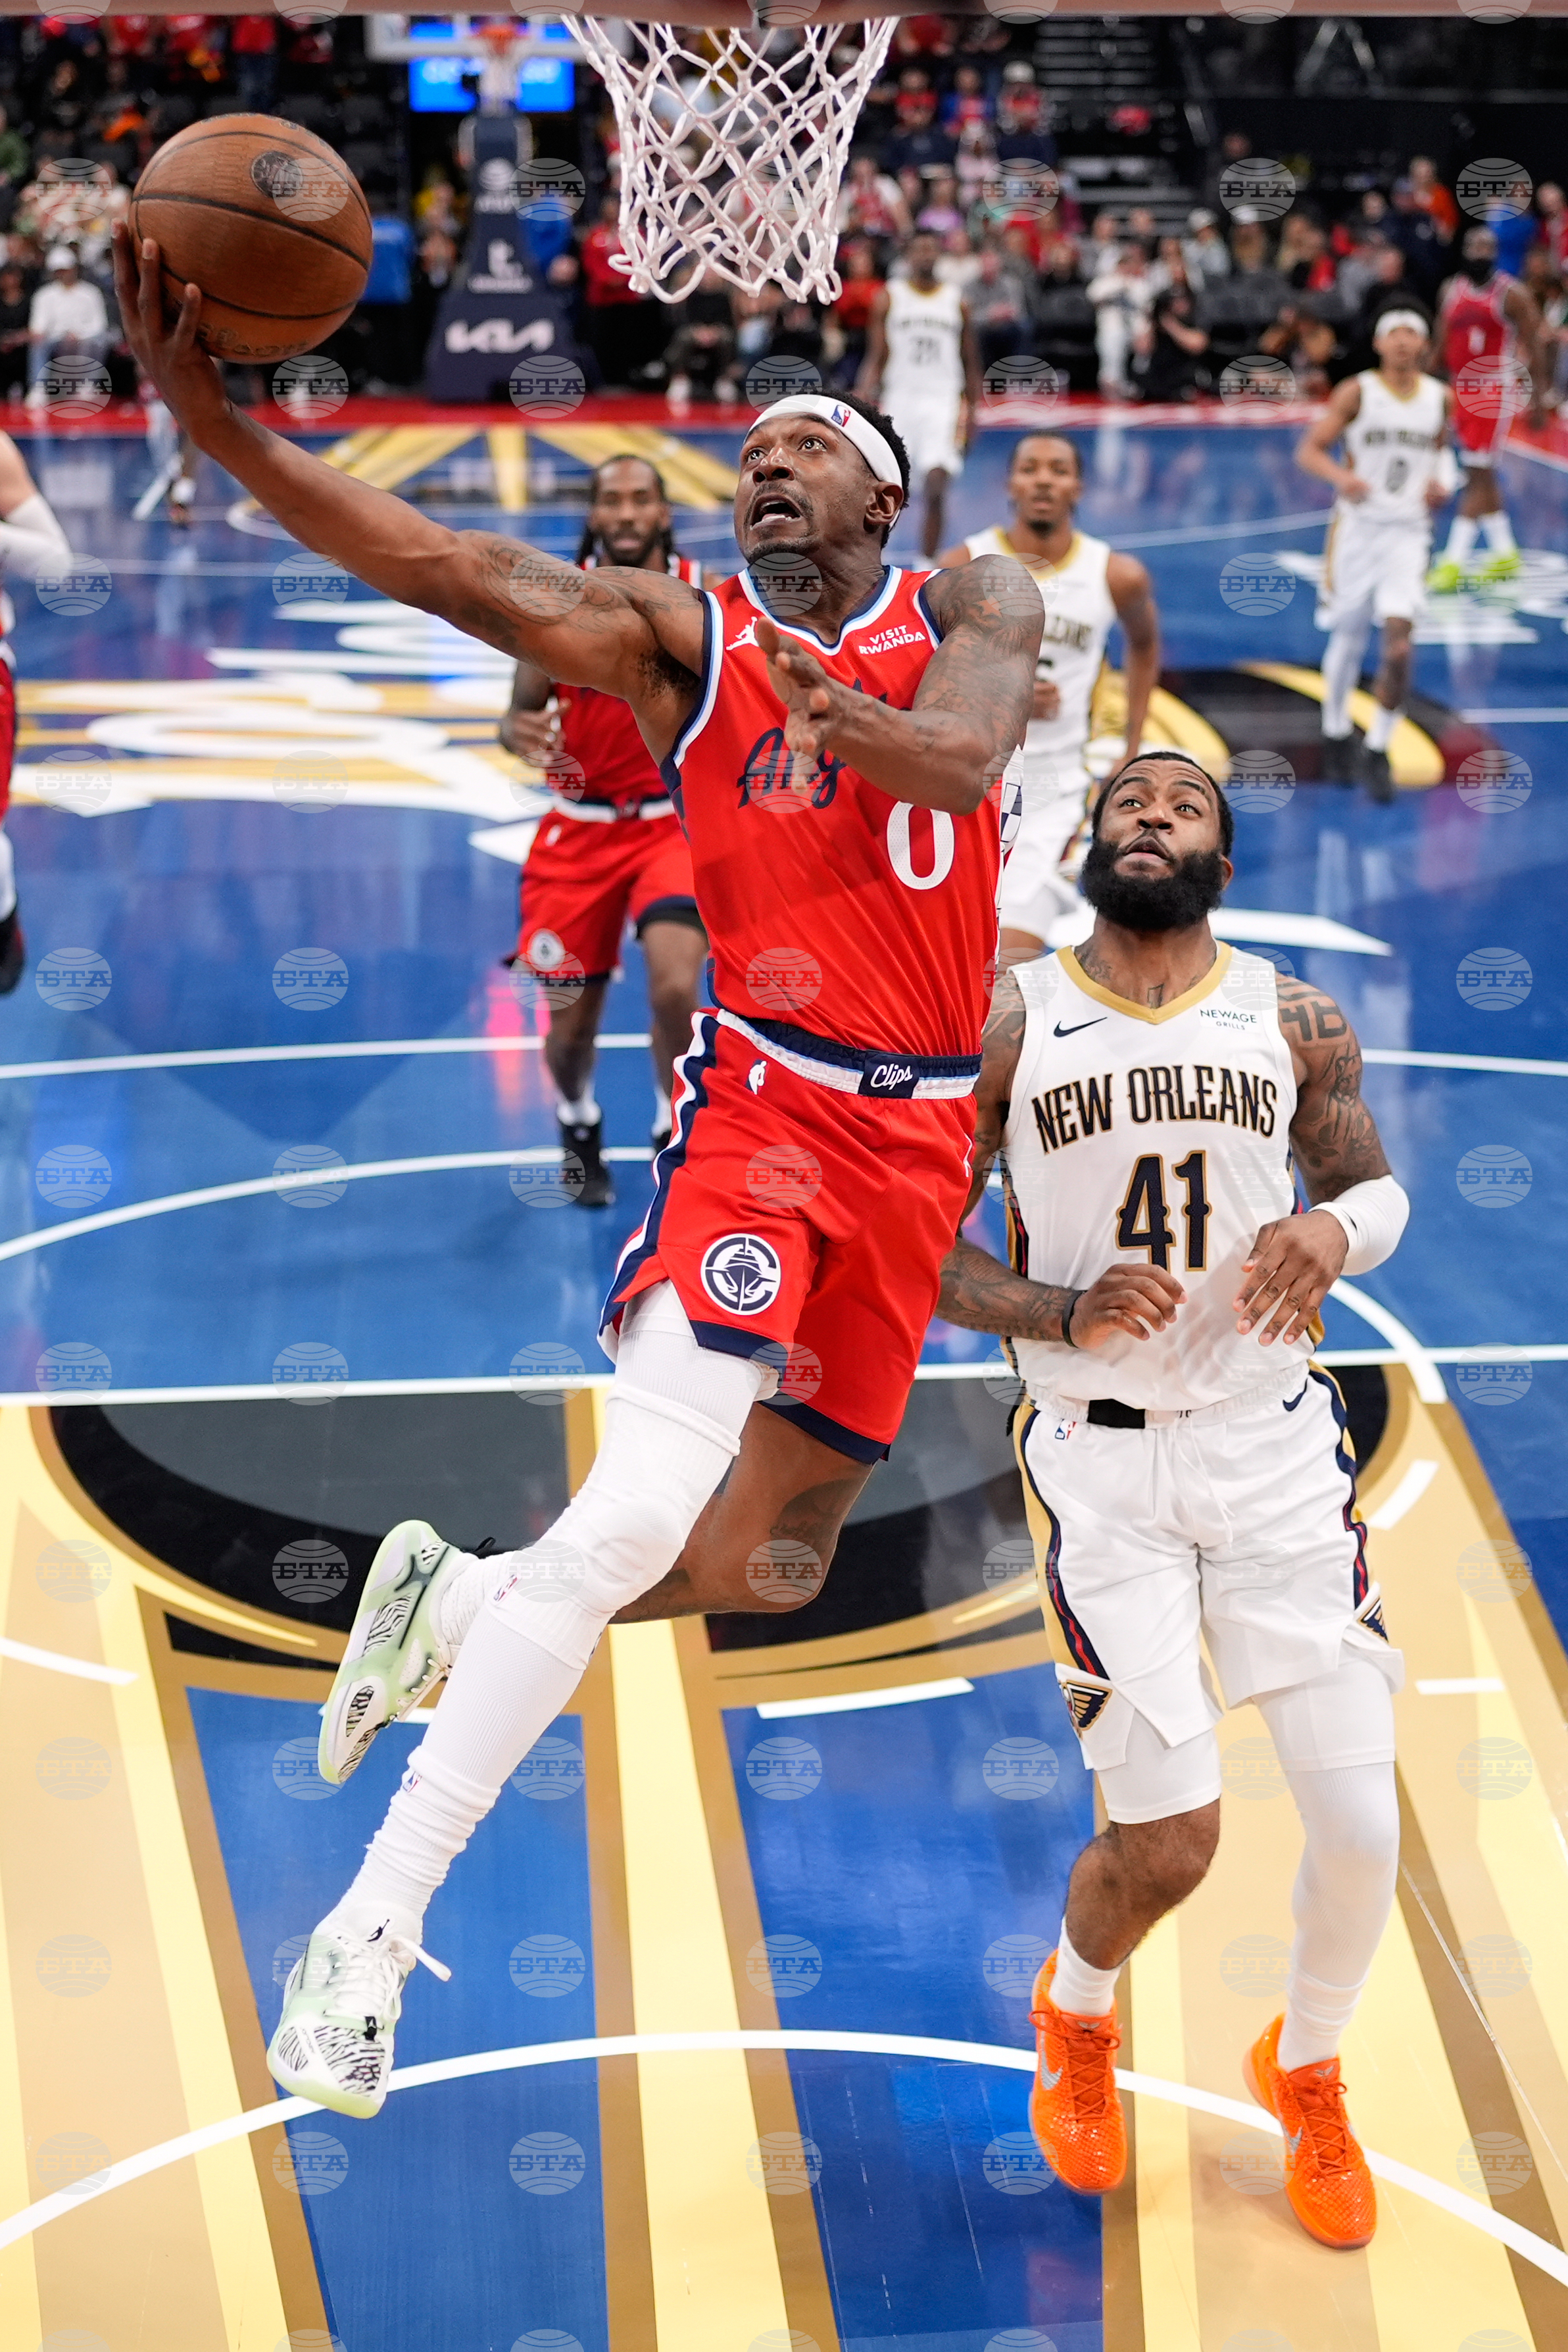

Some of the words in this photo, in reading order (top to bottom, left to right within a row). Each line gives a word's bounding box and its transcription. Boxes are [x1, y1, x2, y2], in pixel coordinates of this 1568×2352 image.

[858, 632, 926, 655] RWANDA
[869, 625, 907, 645] VISIT
[887, 801, 954, 890] 0
[1200, 1009, 1257, 1023] NEWAGE
[1215, 1021, 1246, 1030] GRILLS
[870, 1063, 913, 1090] Clips
[1031, 1073, 1114, 1155] NEW
[1127, 1064, 1277, 1139] ORLEANS
[1115, 1149, 1213, 1274] 41
